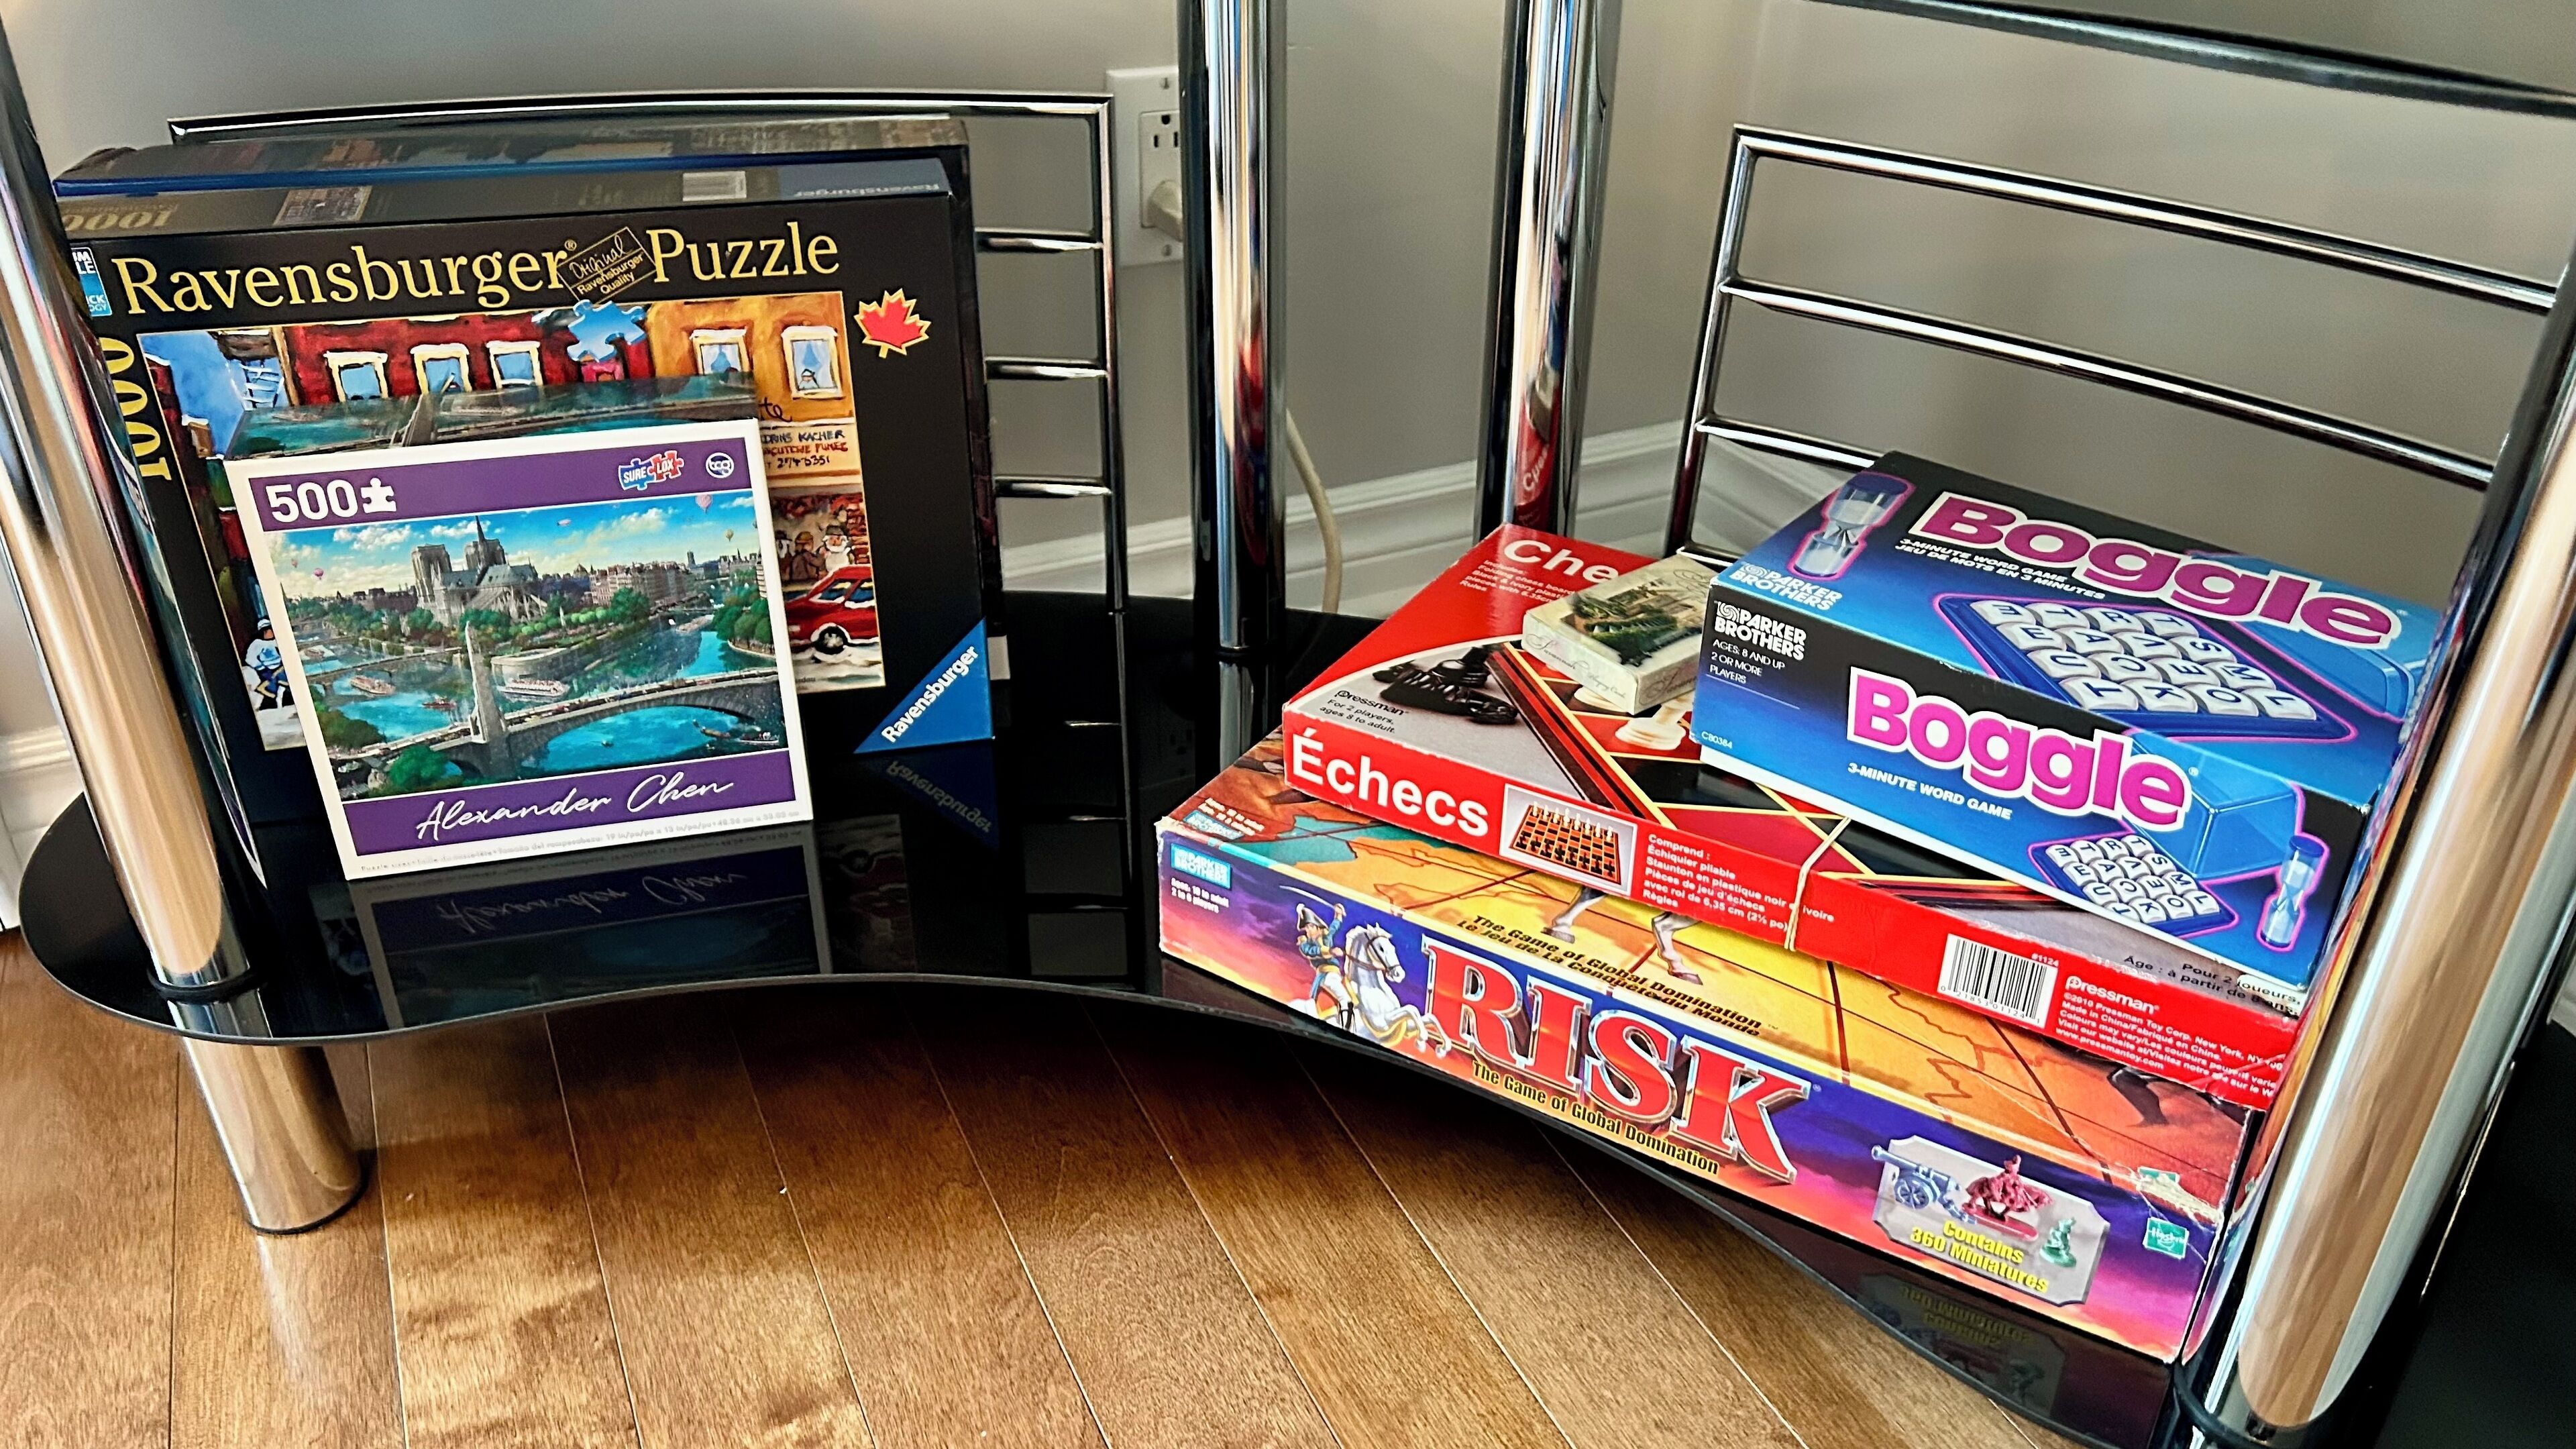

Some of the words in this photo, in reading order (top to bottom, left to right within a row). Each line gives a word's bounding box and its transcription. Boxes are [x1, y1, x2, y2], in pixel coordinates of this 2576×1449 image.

[111, 246, 568, 314] Ravensburger
[646, 222, 840, 282] Puzzle
[570, 235, 627, 279] Original
[577, 254, 643, 294] Ravensburger
[600, 272, 634, 294] Quality
[99, 337, 172, 480] 1000
[623, 466, 647, 483] SURE
[657, 459, 674, 474] LOX
[266, 479, 358, 523] 500
[1504, 539, 1619, 583] Che
[1895, 545, 1927, 555] JEU
[1927, 551, 1947, 561] DE
[1949, 557, 1995, 572] MOTS
[1996, 568, 2020, 578] EN
[2033, 577, 2106, 599] MINUTES
[1900, 539, 1972, 559] 3-MINUTE
[1974, 555, 2019, 571] WORD
[2021, 568, 2069, 583] GAME
[1909, 492, 2404, 650] Boggle
[1460, 580, 1487, 591] Rules
[1729, 571, 1834, 610] BROTHERS
[1764, 570, 1843, 602] PARKER
[1714, 616, 1805, 661] BROTHERS
[1739, 608, 1807, 646] PARKER
[1709, 664, 1747, 684] PLAYERS
[1711, 651, 1717, 660] 2
[1718, 654, 1733, 665] OR
[1735, 659, 1762, 676] MORE
[1713, 639, 1739, 654] AGES:
[1741, 649, 1748, 657] 8
[1750, 651, 1771, 665] AND
[1772, 659, 1785, 669] UP
[881, 645, 979, 743] Ravensburger
[1320, 706, 1344, 717] ages
[1328, 699, 1345, 708] For
[1847, 666, 2192, 833] Boggle
[415, 786, 611, 840] Alexander
[626, 771, 735, 813] Chen
[1292, 729, 1489, 838] Échecs
[1847, 762, 1917, 792] 3-MINUTE
[1919, 782, 1965, 805] WORD
[1967, 798, 2013, 820] GAME
[1648, 834, 1704, 858] Comprend
[1648, 845, 1697, 868] Échiquier
[1699, 863, 1736, 880] pliable
[1643, 889, 1678, 908] Règles
[1644, 879, 1668, 893] avec
[1670, 887, 1685, 898] roi
[1688, 892, 1701, 903] de
[1703, 898, 1725, 911] 6,35
[1727, 906, 1744, 918] cm
[1645, 867, 1680, 884] Pièces
[1682, 879, 1696, 890] de
[1697, 881, 1715, 896] jeu
[1717, 888, 1766, 912] d'échecs
[1646, 857, 1694, 879] Staunton
[1696, 873, 1710, 883] en
[1712, 878, 1762, 901] plastique
[1764, 894, 1786, 908] noir
[1803, 906, 1835, 922] ivoire
[1473, 915, 1505, 932] The
[1508, 929, 1559, 952] Game
[1562, 951, 1586, 961] of
[1587, 957, 1649, 985] Global
[1650, 981, 1762, 1029] Domination
[1515, 942, 1539, 954] de
[1691, 1008, 1760, 1036] Monde
[2167, 969, 2176, 977] à
[2180, 976, 2222, 991] partir
[2227, 988, 2246, 999] de
[2182, 963, 2216, 980] Pour
[2061, 1001, 2087, 1015] Made
[2090, 1010, 2099, 1018] in
[2176, 1040, 2188, 1049] en
[2096, 1002, 2143, 1024] Pressman
[2147, 1019, 2163, 1031] Toy
[2195, 1036, 2217, 1049] New
[1422, 934, 1812, 1186] RISK
[2058, 1018, 2079, 1031] Visit
[2080, 1027, 2097, 1036] our
[2098, 1033, 2135, 1050] website
[2183, 1063, 2210, 1075] notre
[2231, 1079, 2249, 1089] sur
[2250, 1085, 2259, 1093] le
[2059, 1010, 2097, 1028] Colours
[2099, 1021, 2119, 1035] may
[2164, 1046, 2207, 1065] couleurs
[2251, 1076, 2276, 1088] varie
[1472, 1061, 1500, 1085] The
[1503, 1073, 1547, 1104] Game
[1550, 1096, 1568, 1113] of
[1571, 1102, 1621, 1135] Global
[1625, 1122, 1719, 1176] Domination
[1910, 1226, 1946, 1252] 360
[1949, 1242, 2049, 1294] Miniatures
[1943, 1219, 2025, 1265] Contains
